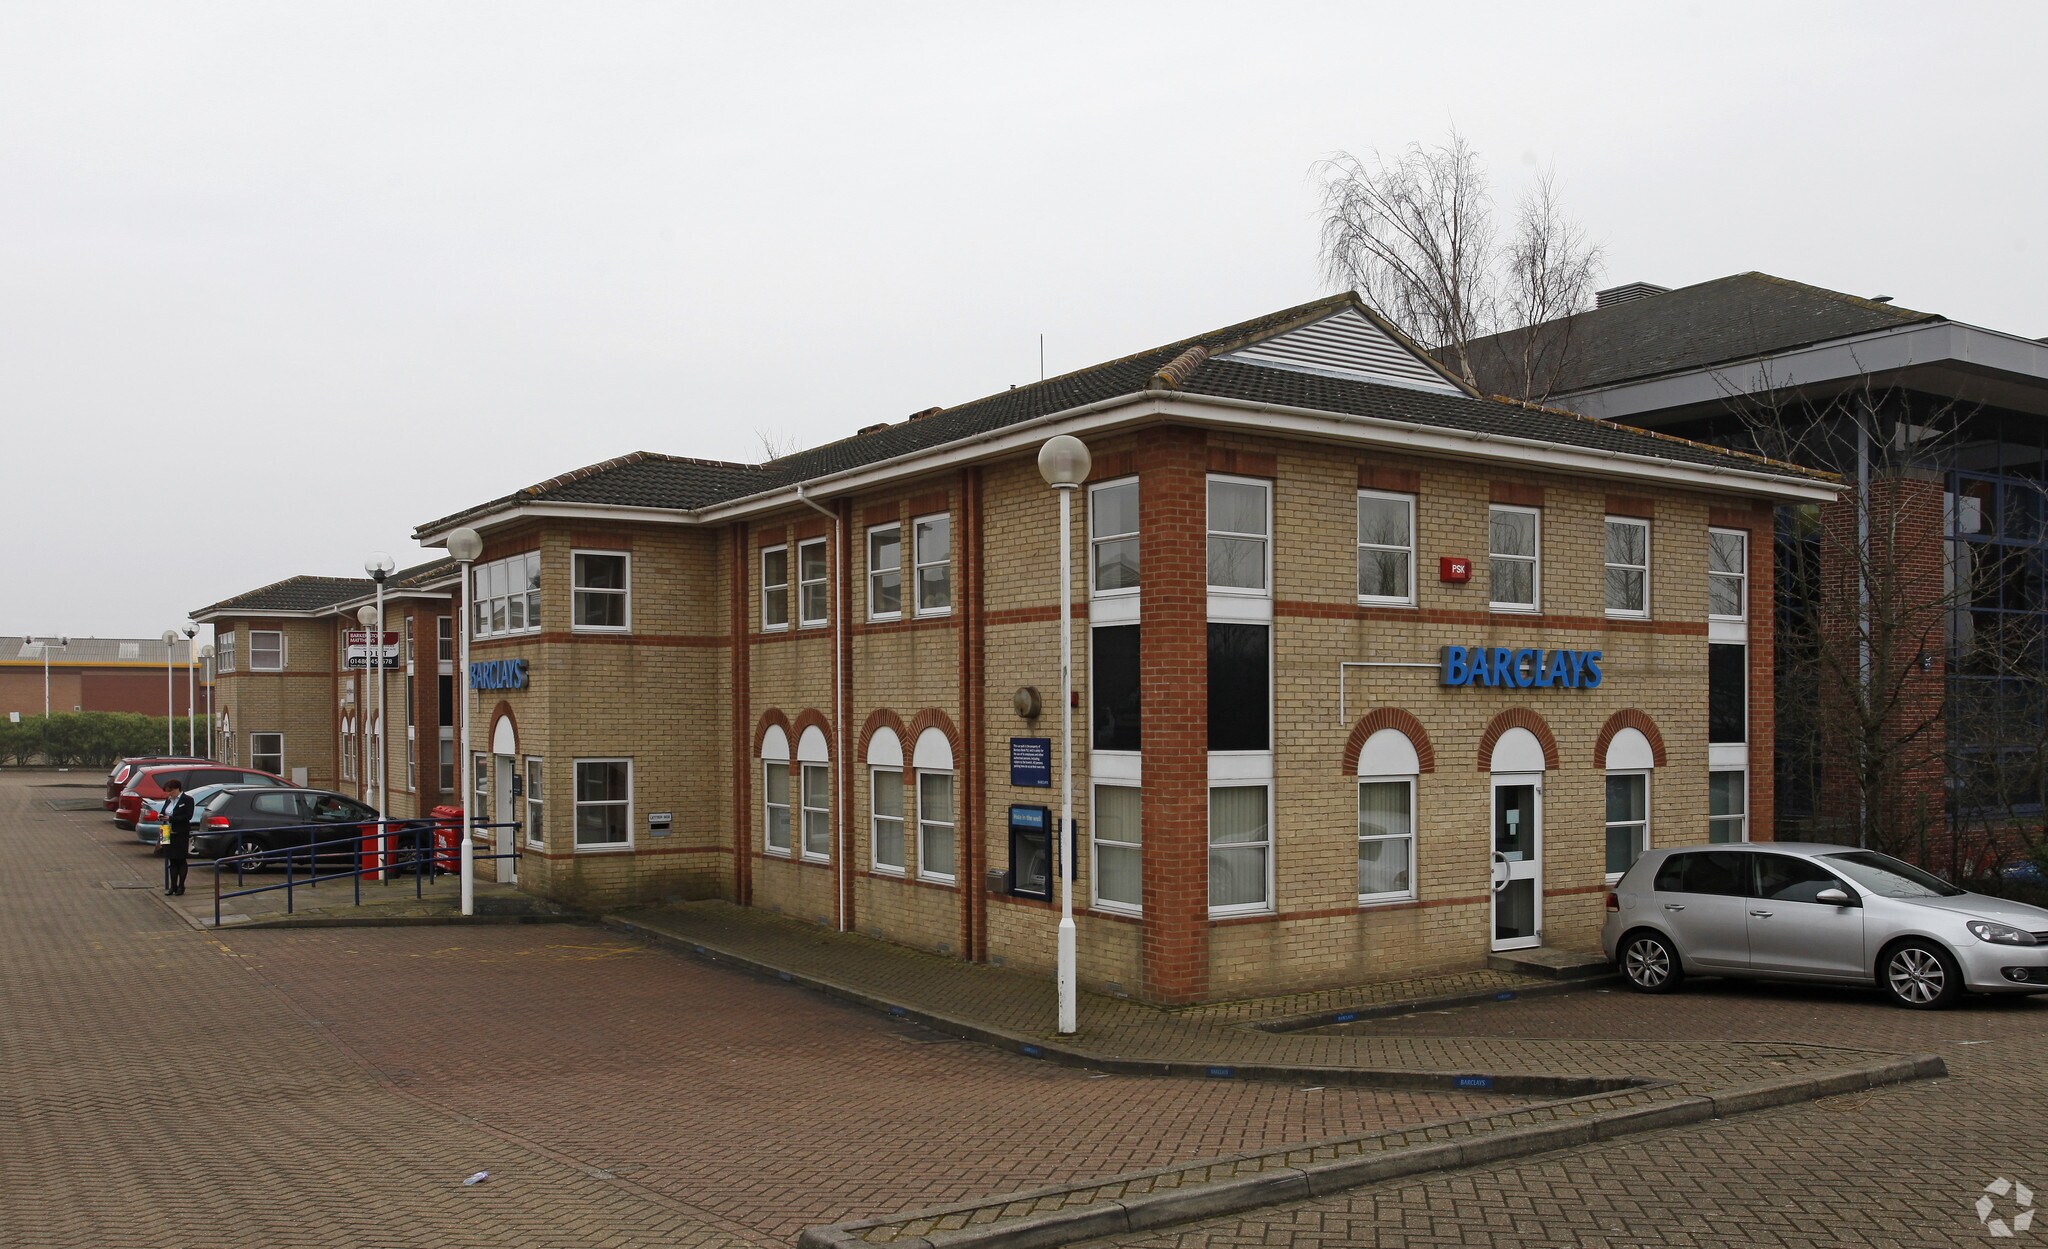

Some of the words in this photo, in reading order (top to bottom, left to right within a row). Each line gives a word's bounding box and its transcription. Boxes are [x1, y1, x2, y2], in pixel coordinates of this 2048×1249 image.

[1452, 564, 1465, 573] PSK
[470, 658, 525, 689] BARCLAYS
[1445, 645, 1602, 688] BARCLAYS
